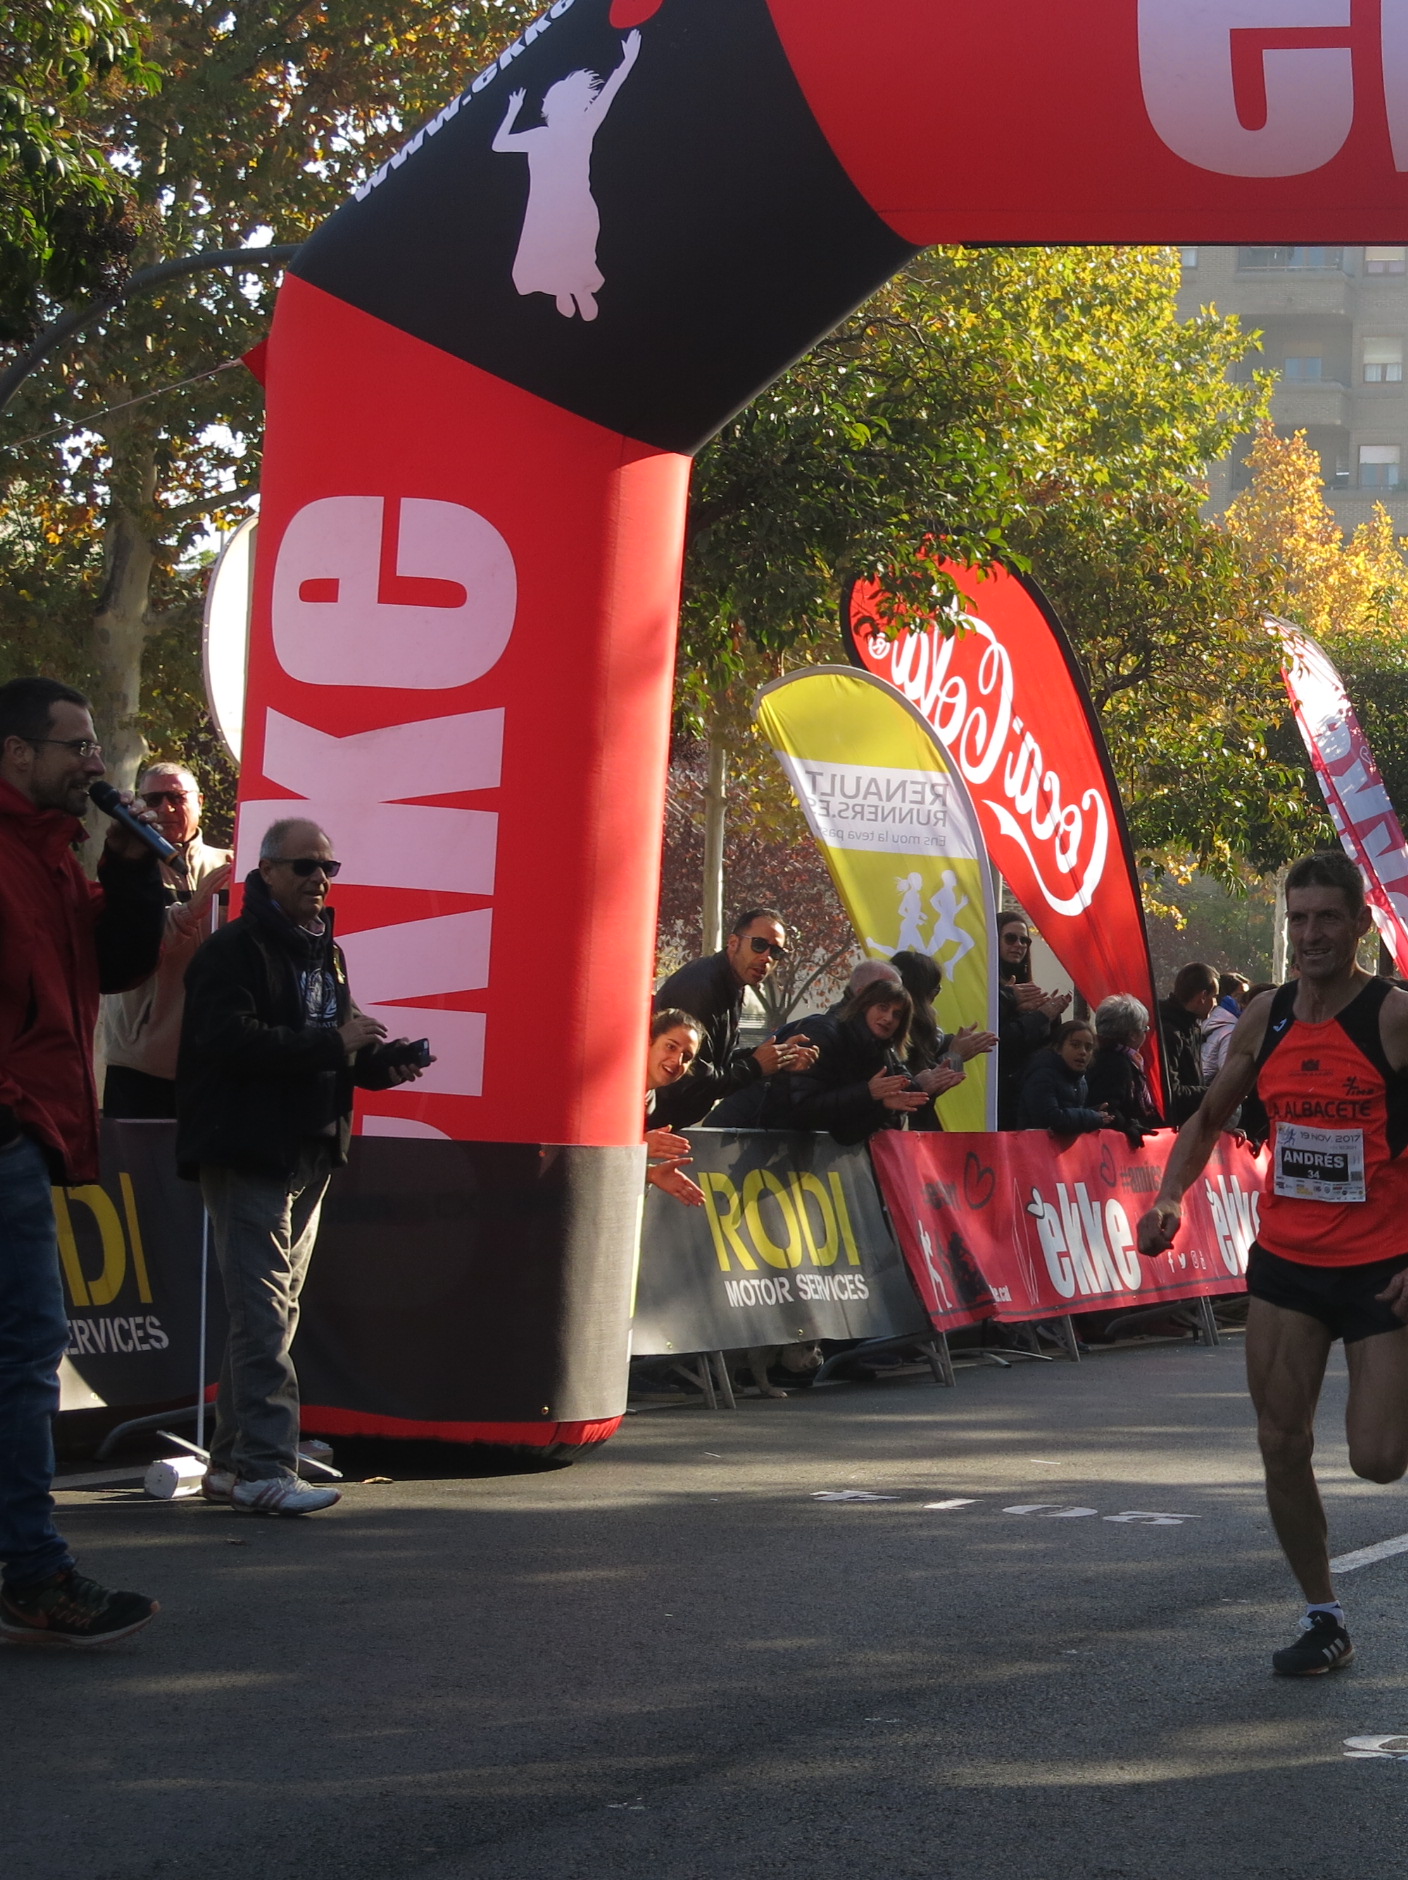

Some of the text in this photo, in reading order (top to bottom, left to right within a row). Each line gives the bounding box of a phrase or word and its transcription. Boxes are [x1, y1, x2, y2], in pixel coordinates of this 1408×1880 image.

[1281, 1101, 1372, 1119] ALBACETE
[1283, 1150, 1345, 1169] ANDRÉS
[1307, 1169, 1320, 1180] 34
[698, 1168, 861, 1272] RODI
[1037, 1181, 1142, 1299] ekke
[723, 1272, 870, 1311] MOTOR SERVICES
[62, 1314, 170, 1356] ERVICES
[808, 1489, 1202, 1525] 2014
